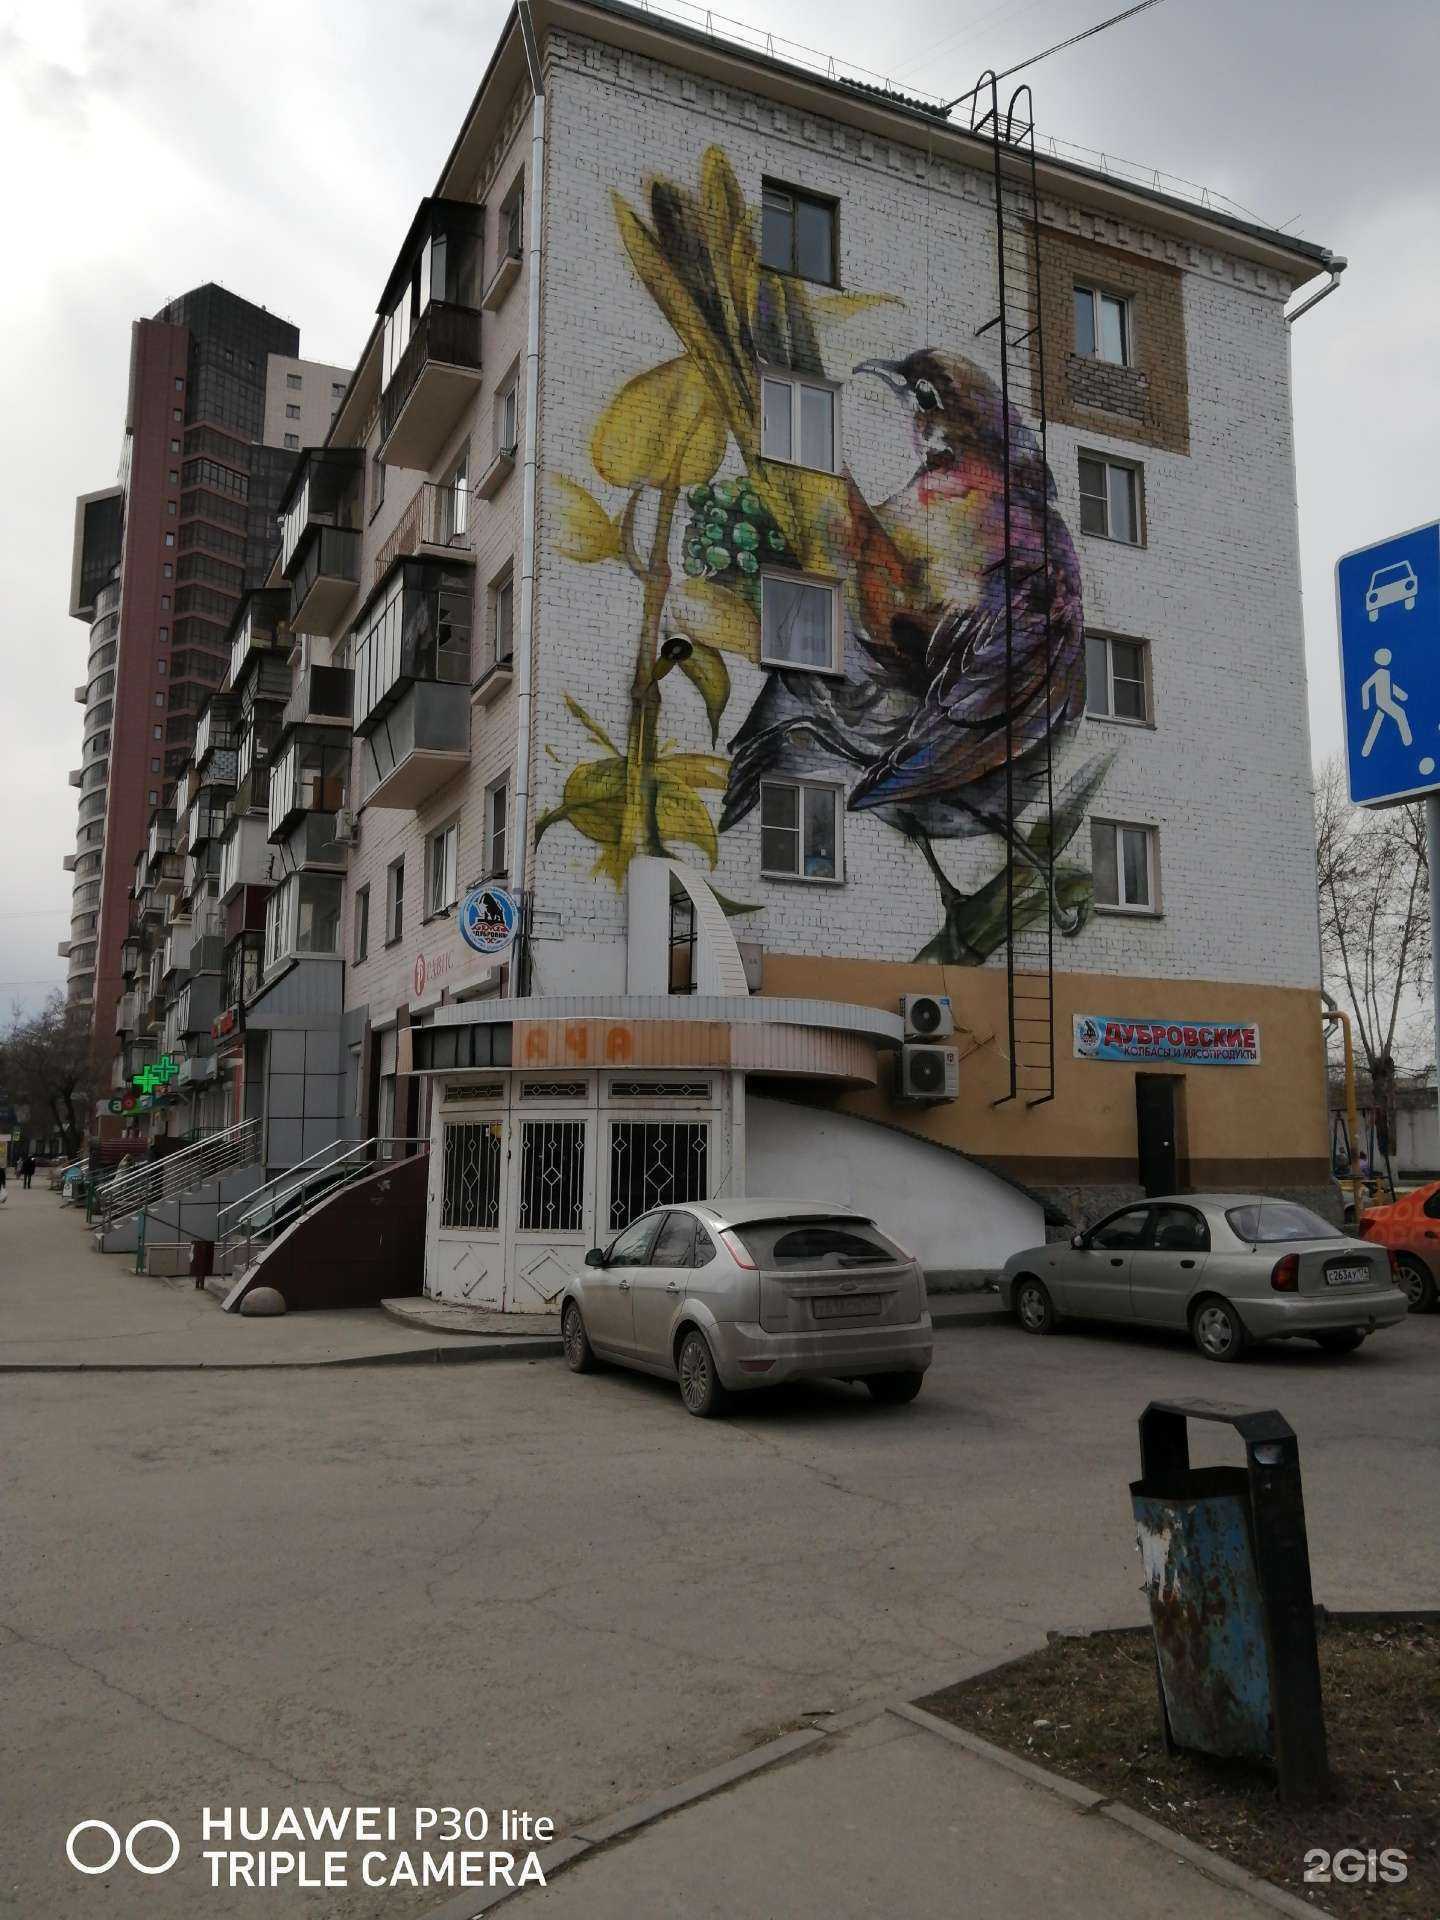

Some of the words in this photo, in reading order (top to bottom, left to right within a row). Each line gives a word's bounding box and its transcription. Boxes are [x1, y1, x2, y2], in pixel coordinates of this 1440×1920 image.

[1104, 1022, 1256, 1048] ДУБРОВСКИЕ
[1124, 1046, 1170, 1057] КОЛБАСЫ
[1174, 1048, 1181, 1057] И
[1184, 1048, 1257, 1060] МЯСОПРОДУКТЫ
